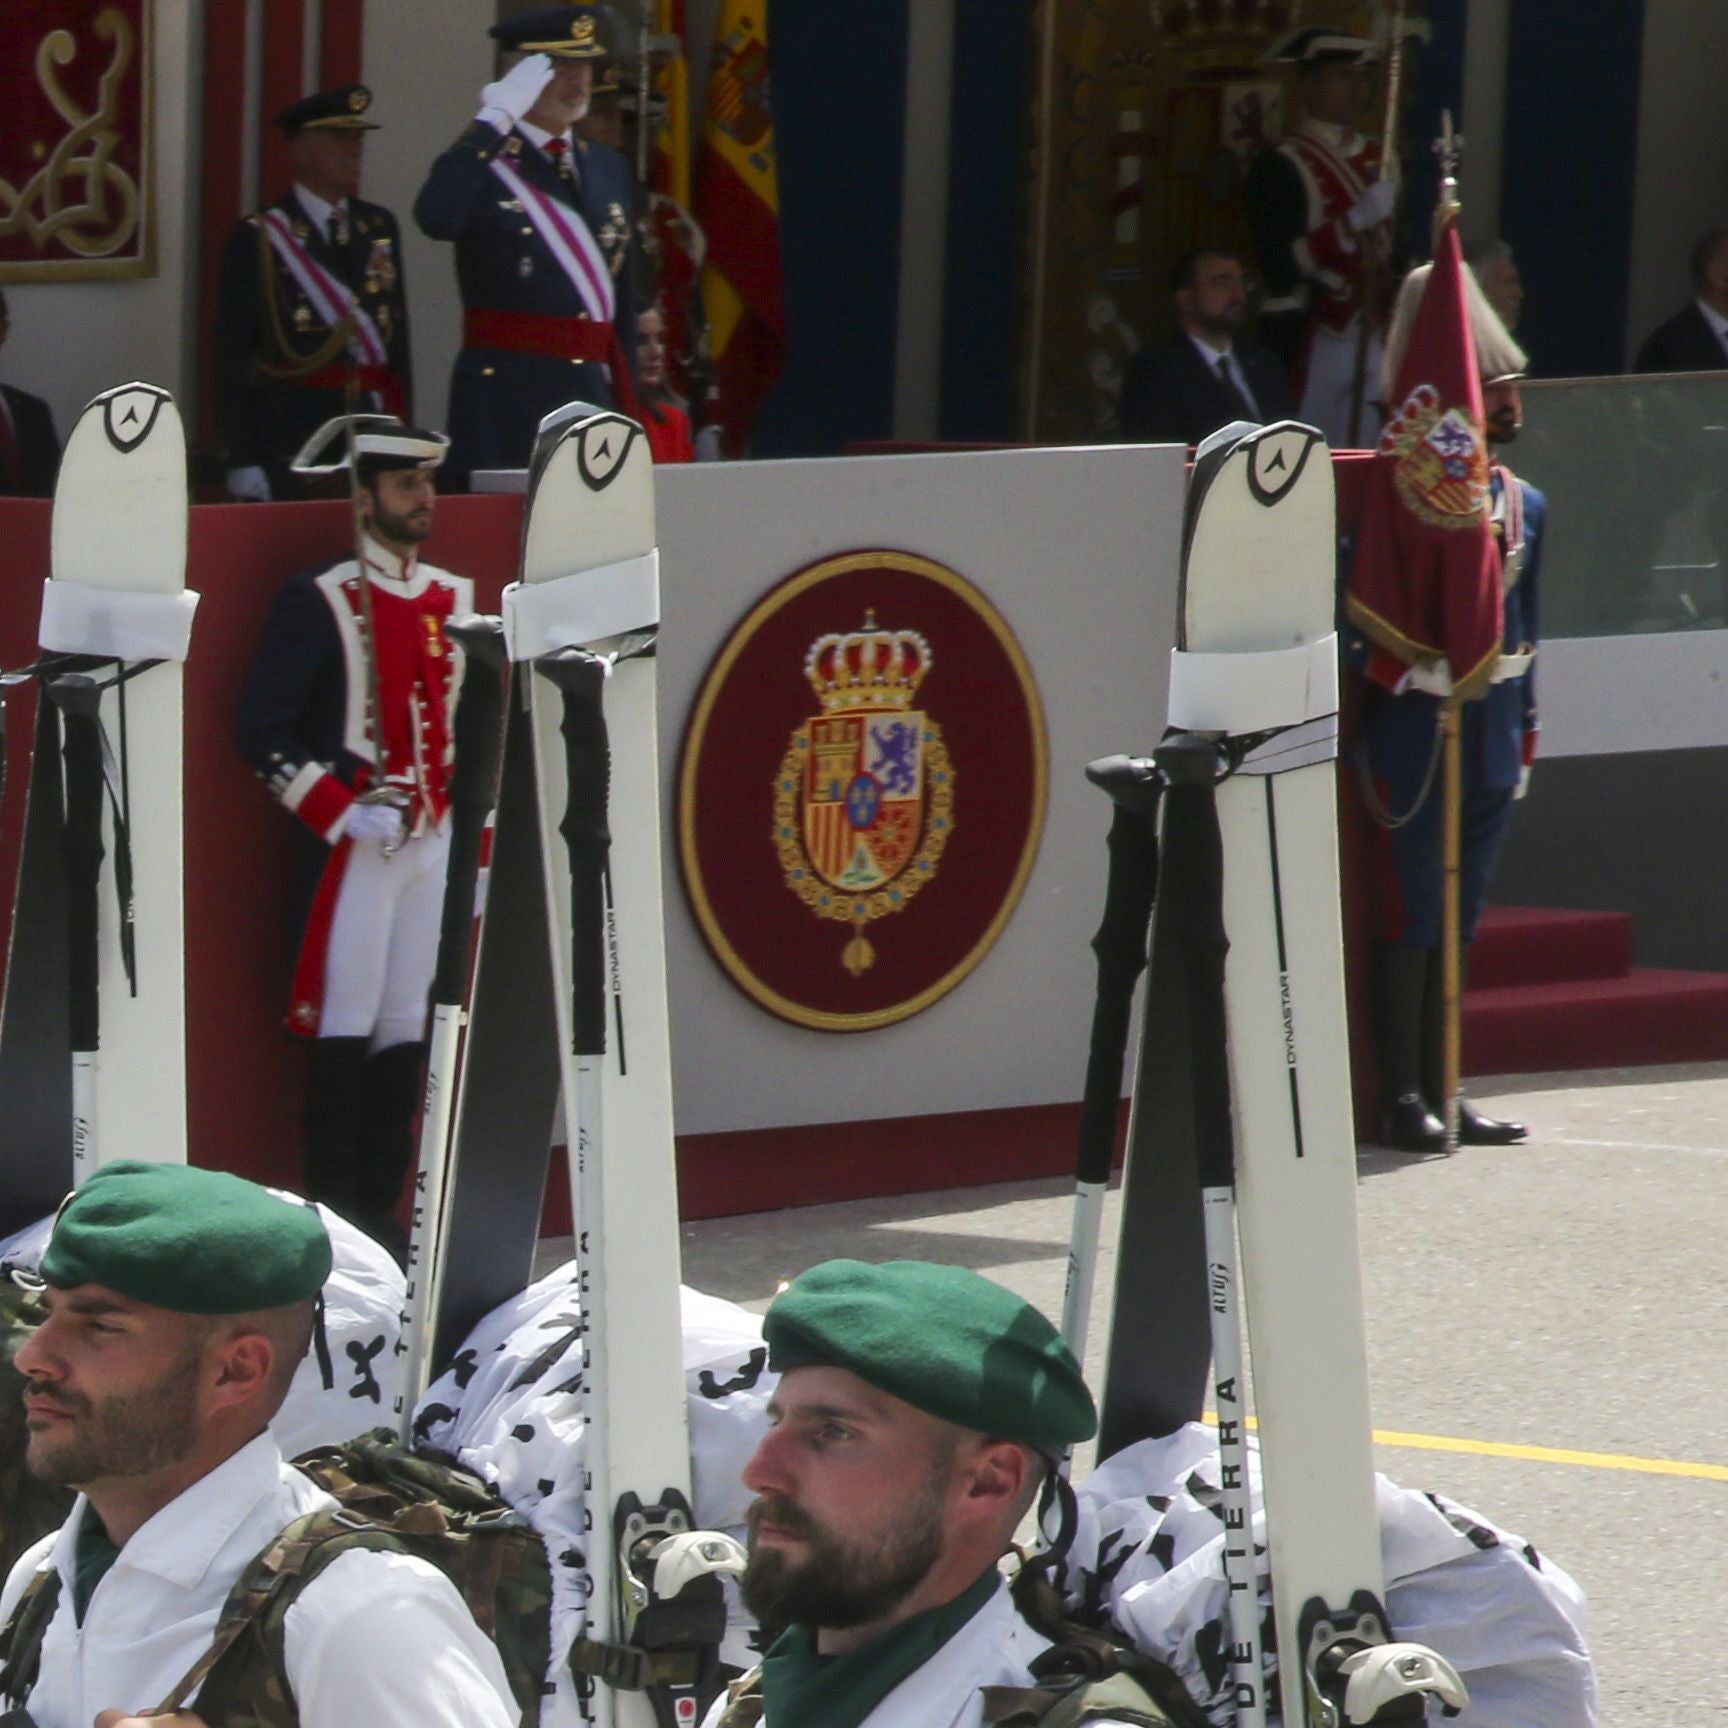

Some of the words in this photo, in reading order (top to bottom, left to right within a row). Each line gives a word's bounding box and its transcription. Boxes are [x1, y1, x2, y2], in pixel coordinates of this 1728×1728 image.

[608, 910, 623, 993] DYNASTAR
[1279, 972, 1296, 1065] DYNASTAR
[1210, 1272, 1230, 1313] ALTUS
[1214, 1377, 1249, 1597] TIERRA
[1231, 1642, 1256, 1707] DE
